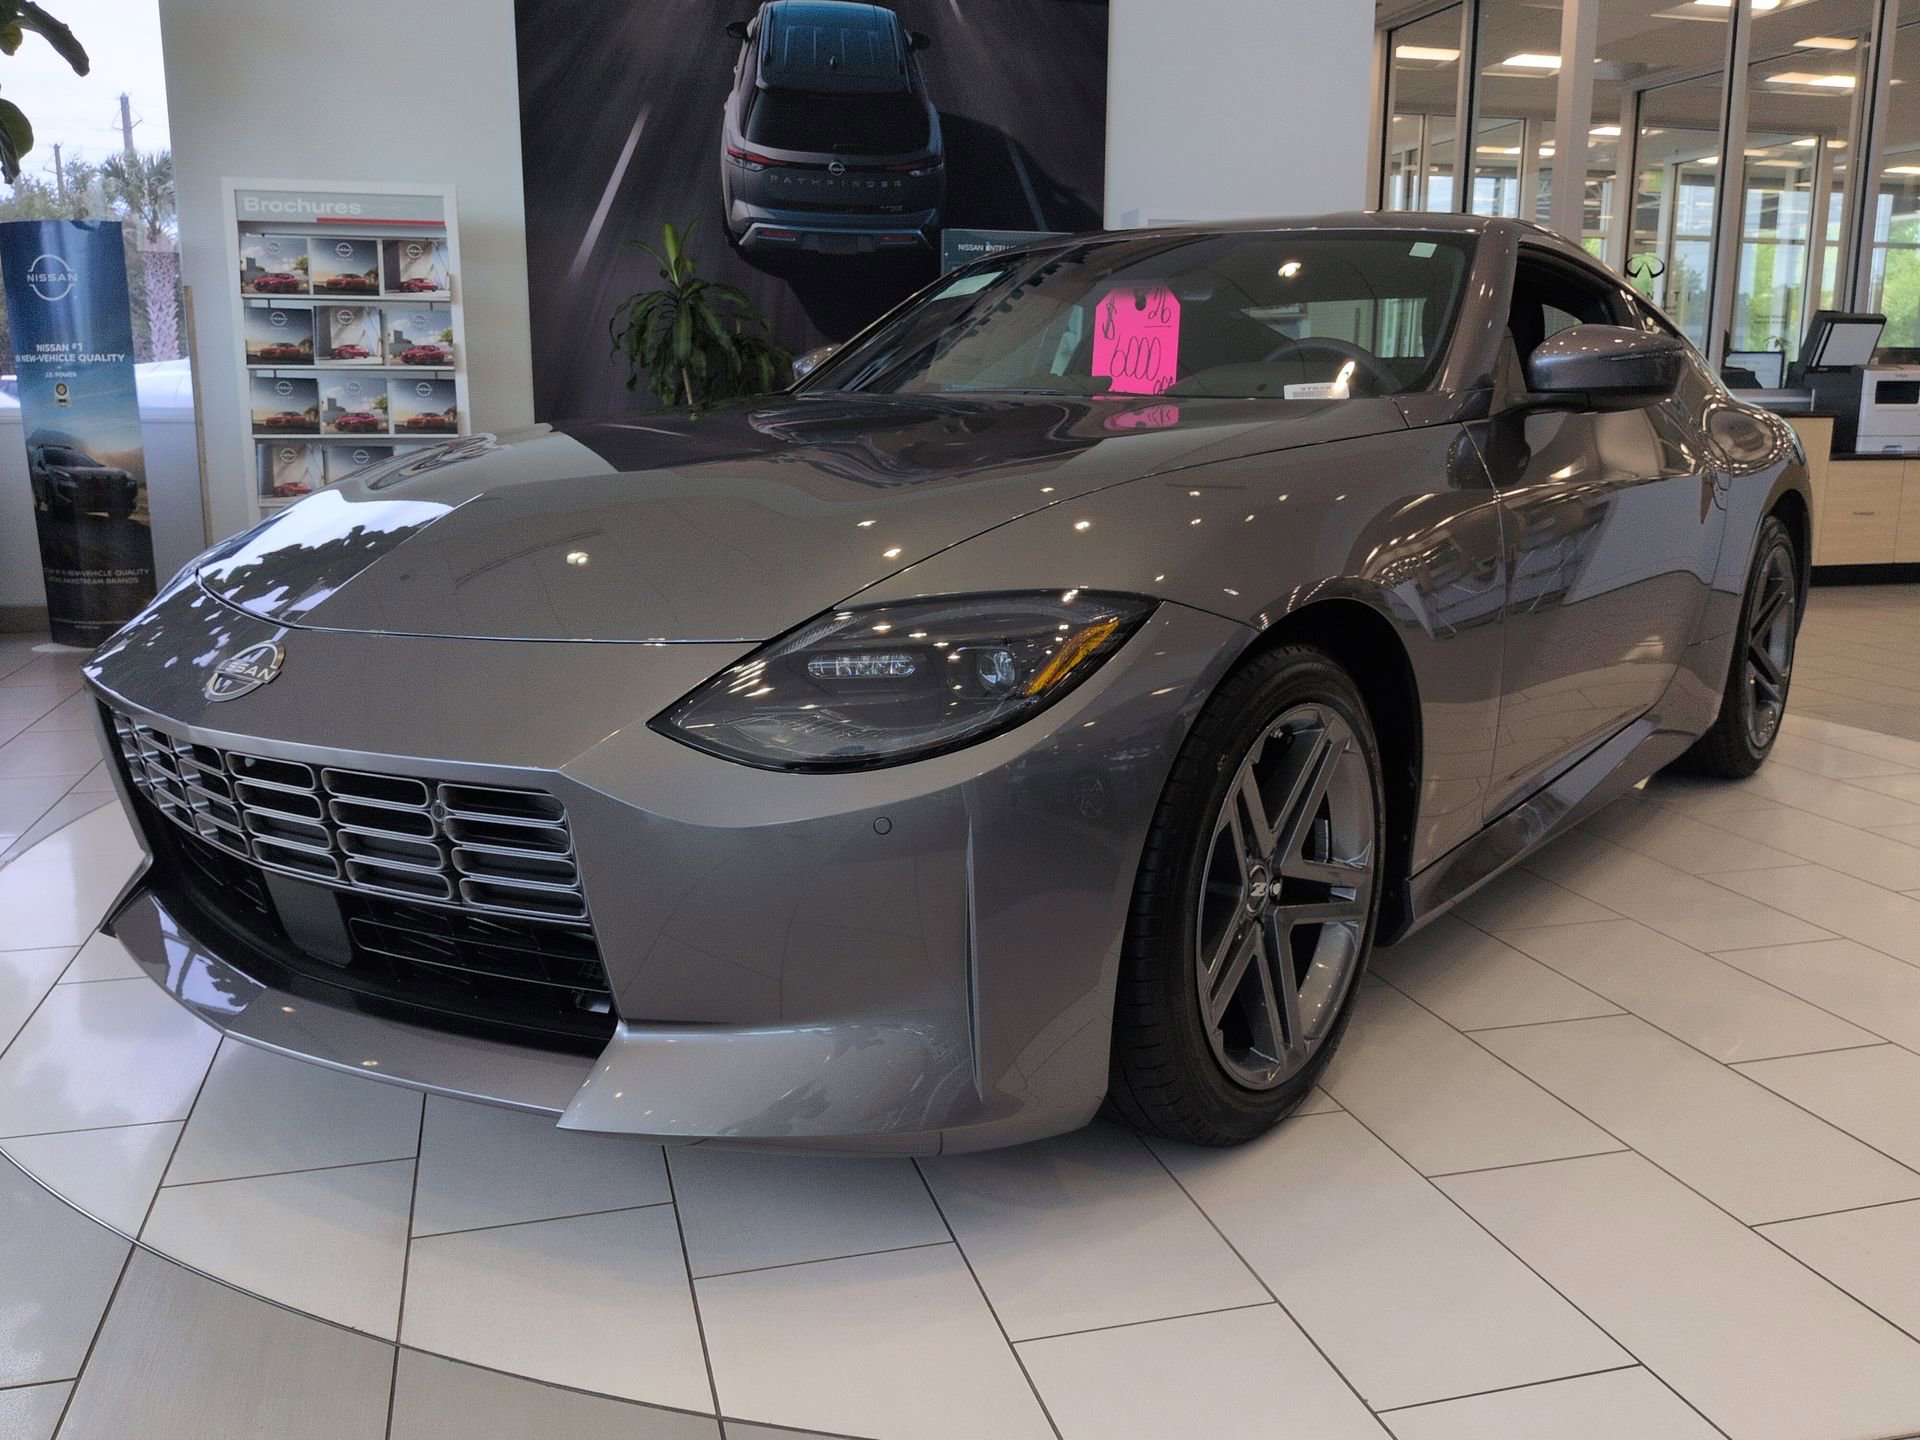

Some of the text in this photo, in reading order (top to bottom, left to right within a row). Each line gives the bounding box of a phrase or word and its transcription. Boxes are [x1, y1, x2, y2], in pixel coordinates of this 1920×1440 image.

[243, 197, 363, 214] Brochures
[958, 243, 984, 252] NISSAN
[26, 273, 78, 283] NISSAN
[36, 343, 70, 353] NISSAN
[21, 353, 77, 364] NEW-VEHICLE
[78, 353, 125, 364] QUALITY
[1109, 334, 1161, 381] 6000
[217, 660, 276, 681] NISSAN
[1250, 882, 1267, 897] Z
